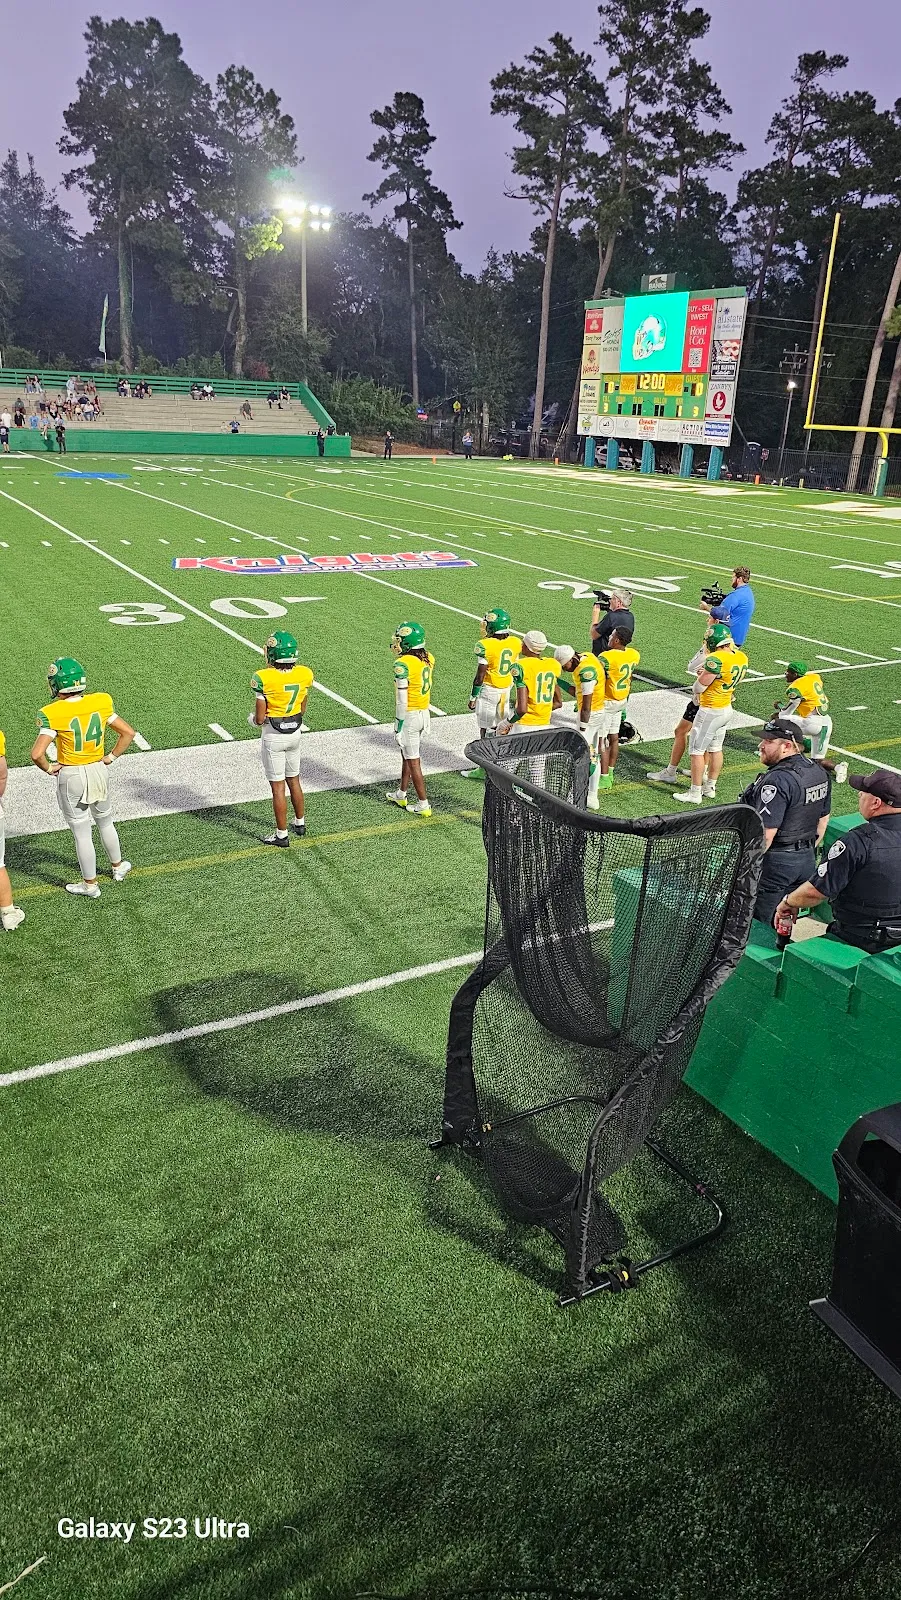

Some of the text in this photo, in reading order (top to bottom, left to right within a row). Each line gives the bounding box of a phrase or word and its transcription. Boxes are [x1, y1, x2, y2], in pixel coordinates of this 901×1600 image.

[690, 313, 708, 321] INVEST
[701, 304, 713, 312] SELL
[685, 374, 704, 383] GUEST
[499, 649, 513, 675] 6
[421, 667, 431, 696] 8
[535, 672, 556, 704] 13
[283, 683, 300, 714] 7
[69, 712, 103, 752] 14
